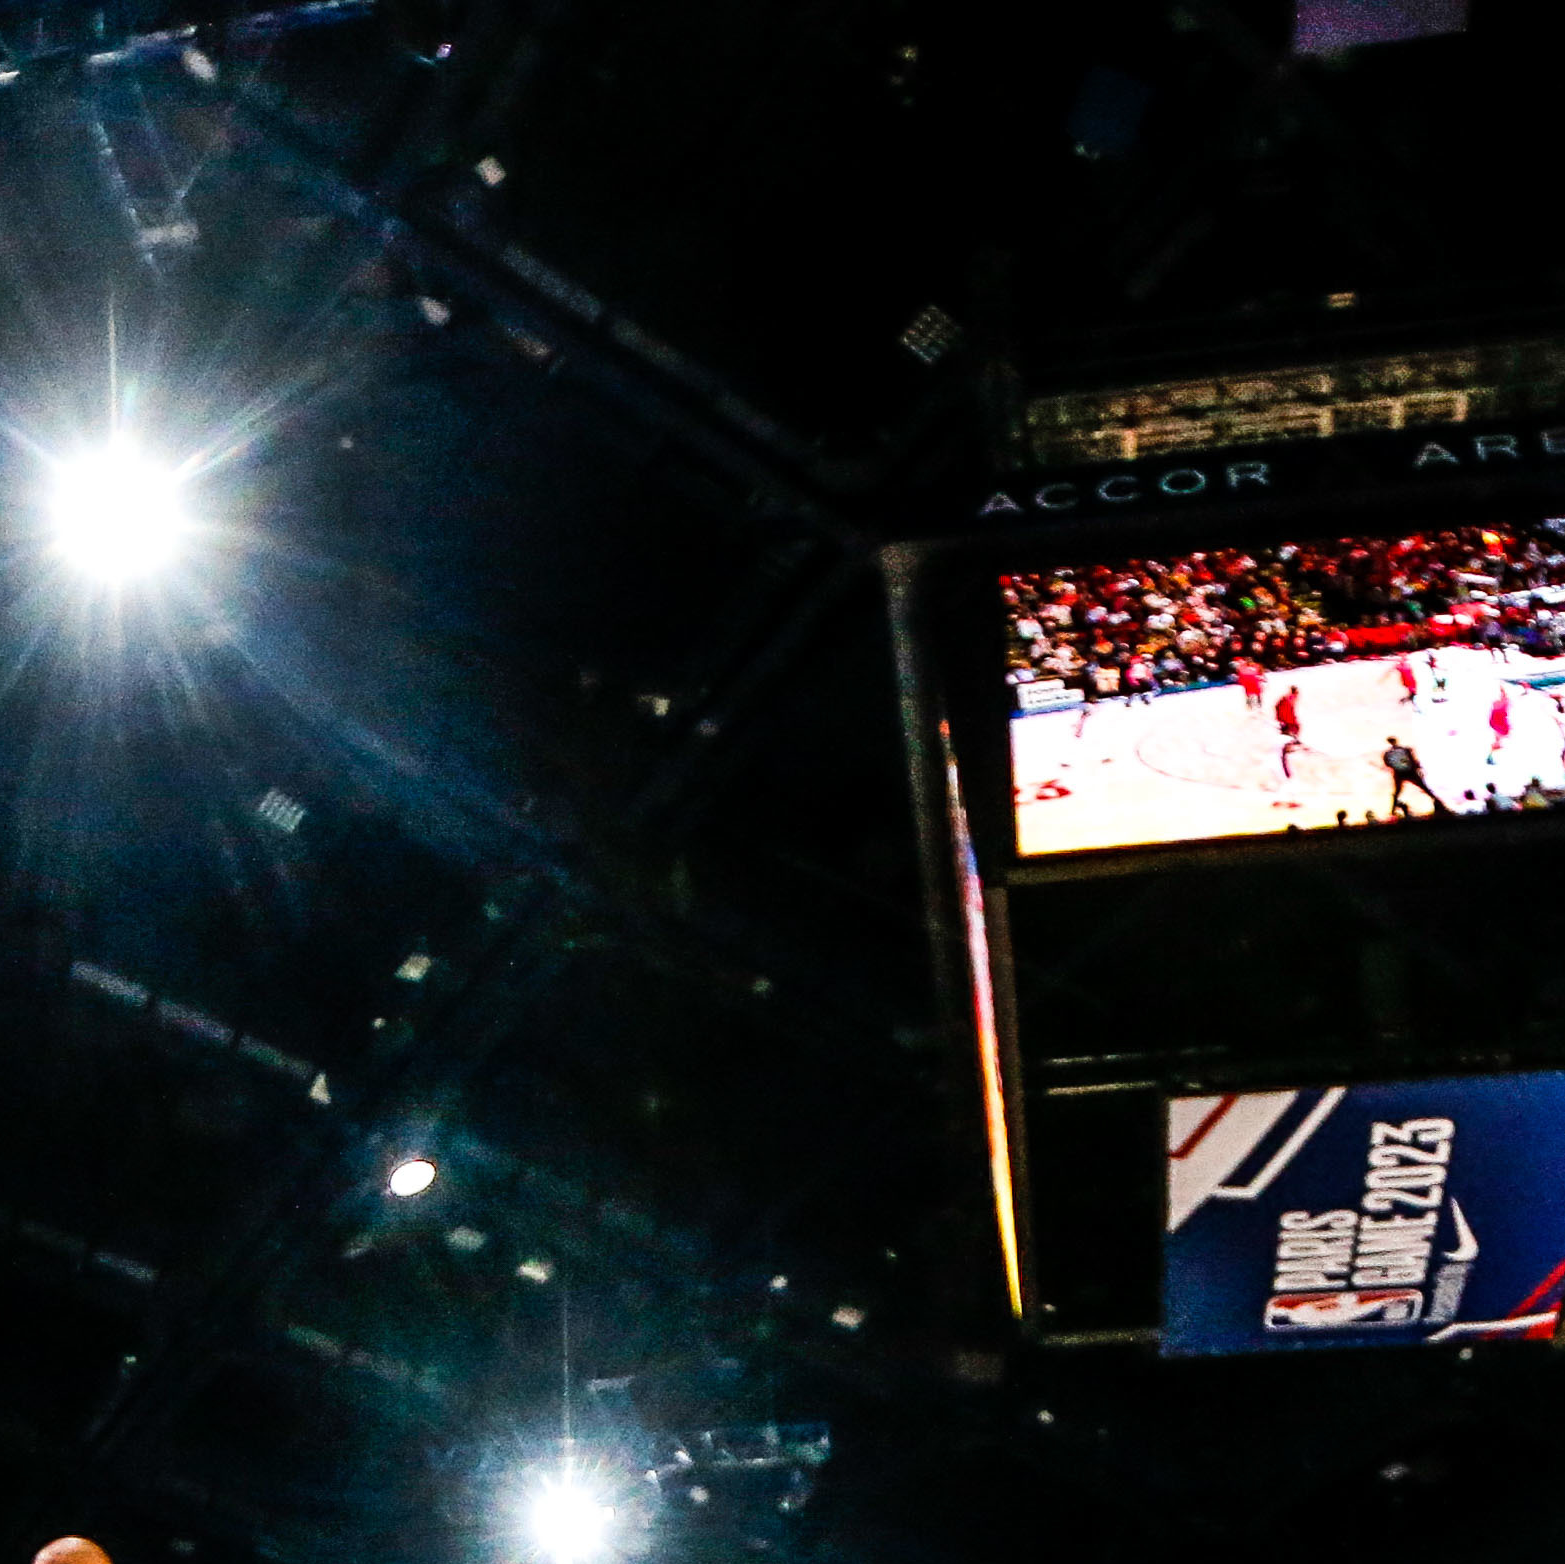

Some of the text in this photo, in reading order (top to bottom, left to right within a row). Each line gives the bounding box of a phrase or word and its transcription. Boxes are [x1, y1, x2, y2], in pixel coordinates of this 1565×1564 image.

[977, 460, 1270, 516] ACCOR
[1351, 1118, 1455, 1287] GAME 2023
[1274, 1209, 1358, 1291] PARIS
